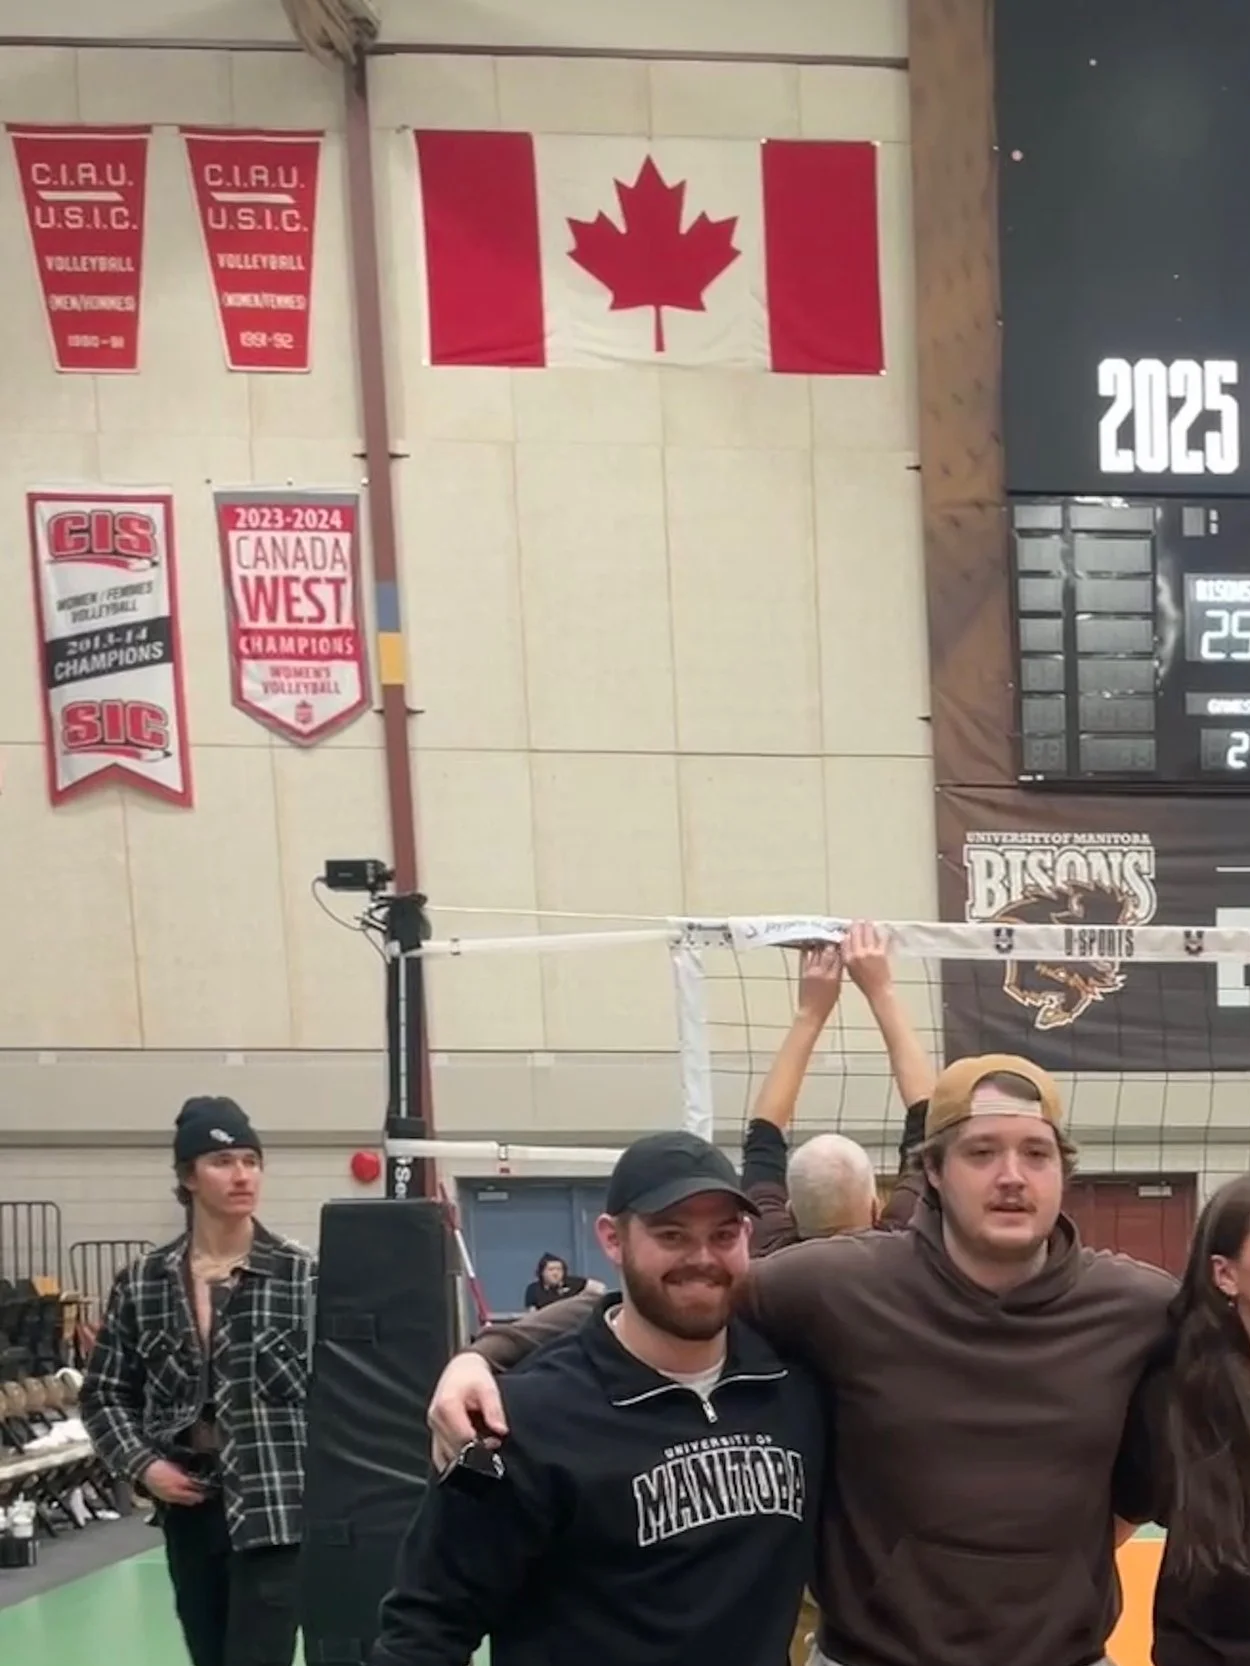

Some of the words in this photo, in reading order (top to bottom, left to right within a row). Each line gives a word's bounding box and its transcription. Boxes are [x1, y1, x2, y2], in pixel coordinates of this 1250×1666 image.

[34, 206, 138, 230] U.S.I.C.
[207, 208, 309, 232] U.S.I.C.
[45, 255, 135, 272] VOLLEYBALL
[216, 253, 305, 270] VOLLEYBALL
[1097, 357, 1240, 475] 2025
[234, 507, 343, 529] 2023-2024
[47, 510, 157, 560] CIS
[236, 535, 348, 571] CANADA
[70, 602, 138, 625] VOLLEYBALL
[239, 574, 347, 624] WEST
[238, 635, 354, 656] CHAMPIONS
[53, 641, 164, 682] CHAMPIONS
[60, 699, 169, 749] SIC
[1226, 731, 1250, 769] 2
[966, 832, 1050, 844] UNIVERSITY
[1052, 832, 1069, 844] OF
[1072, 832, 1151, 845] MANITOBA
[963, 844, 1157, 924] BISONS
[664, 1434, 751, 1458] UNIVERSITY
[632, 1445, 806, 1547] MANITOBA
